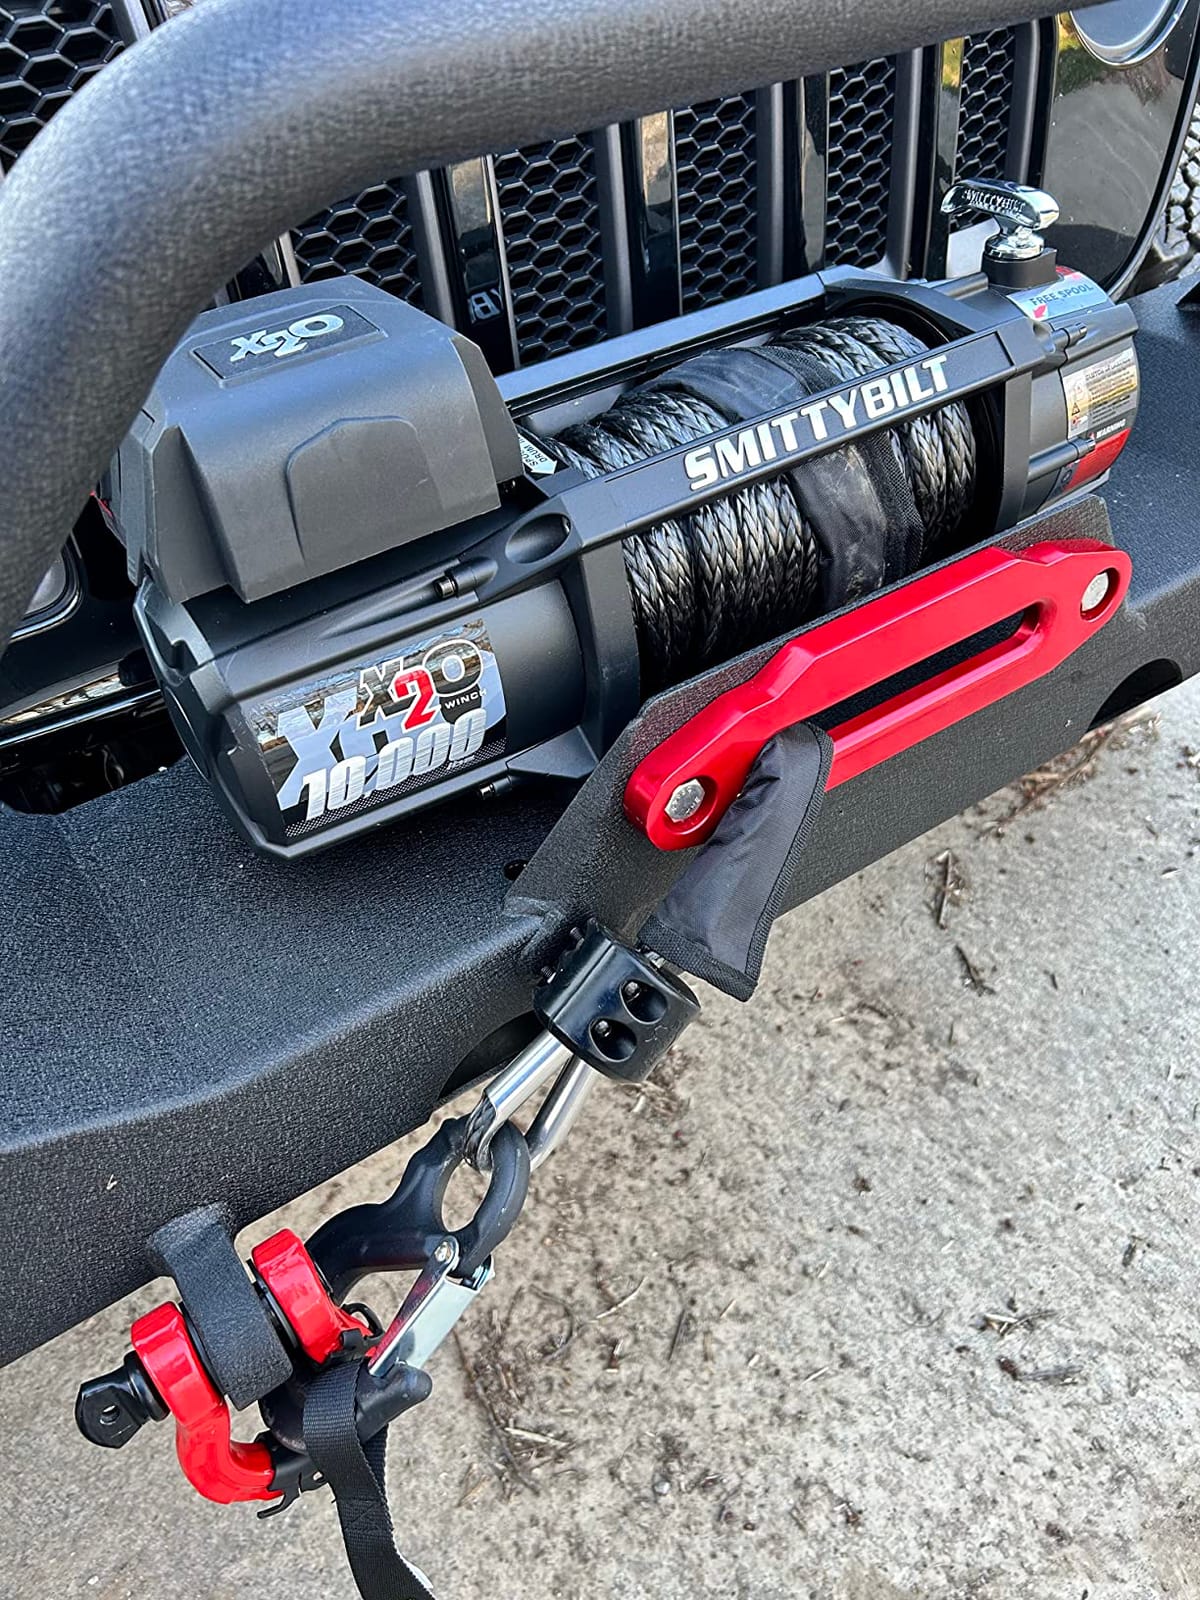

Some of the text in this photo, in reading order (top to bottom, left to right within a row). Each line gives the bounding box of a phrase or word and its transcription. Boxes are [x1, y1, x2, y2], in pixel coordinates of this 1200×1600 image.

[1029, 283, 1094, 306] FREE SPOOL
[684, 355, 948, 491] SMITTYBILT
[523, 444, 548, 463] DRUM
[444, 688, 487, 710] WINCH
[302, 708, 487, 821] 10,000
